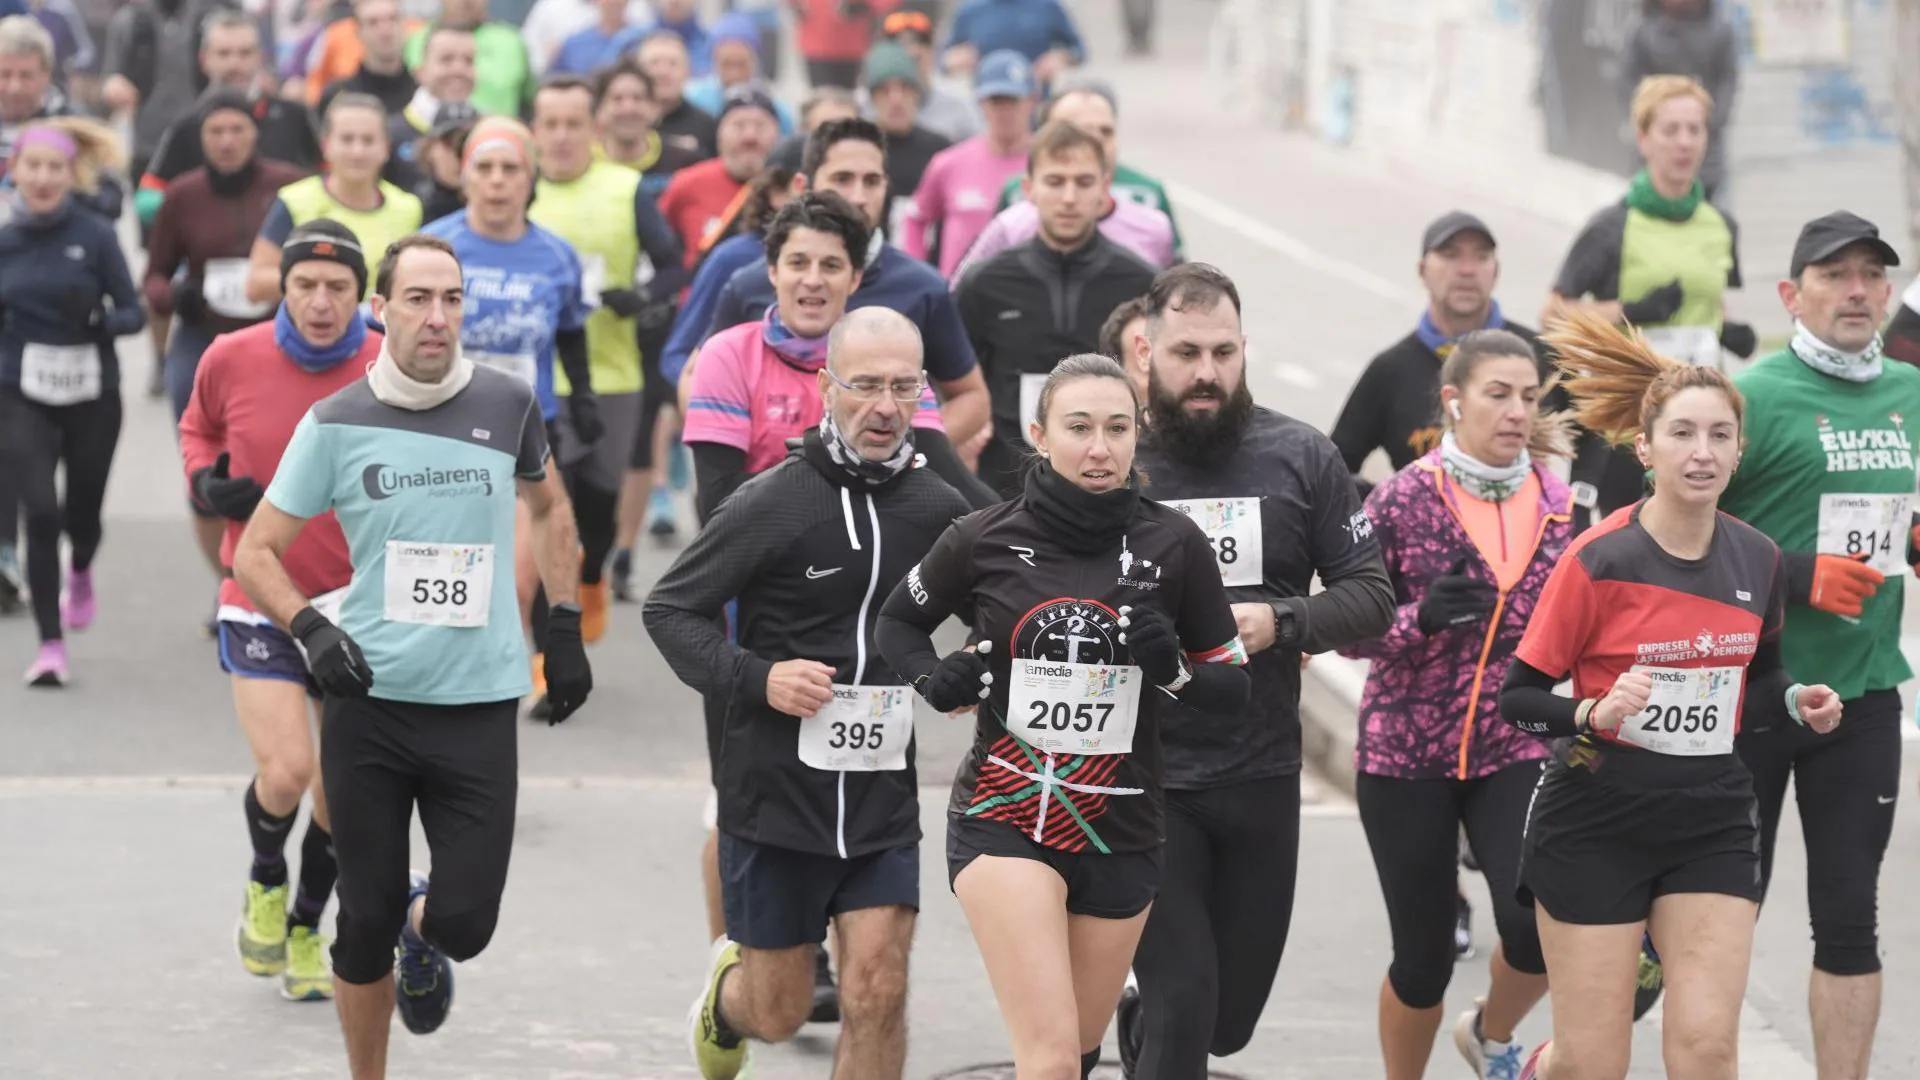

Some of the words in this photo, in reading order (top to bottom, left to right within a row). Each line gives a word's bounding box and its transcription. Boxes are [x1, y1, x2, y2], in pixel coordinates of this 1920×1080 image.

[1819, 429, 1911, 452] EUSKAL
[1826, 449, 1914, 472] HERRIA
[382, 467, 491, 490] Unaiarena
[1207, 536, 1238, 564] 8
[1846, 530, 1891, 556] 814
[412, 578, 468, 605] 538
[908, 562, 929, 606] MEO
[1637, 640, 1690, 654] ENPRESEN
[1024, 664, 1073, 677] lamedia
[1027, 700, 1115, 732] 2057
[1641, 704, 1719, 733] 2056
[828, 721, 884, 750] 395
